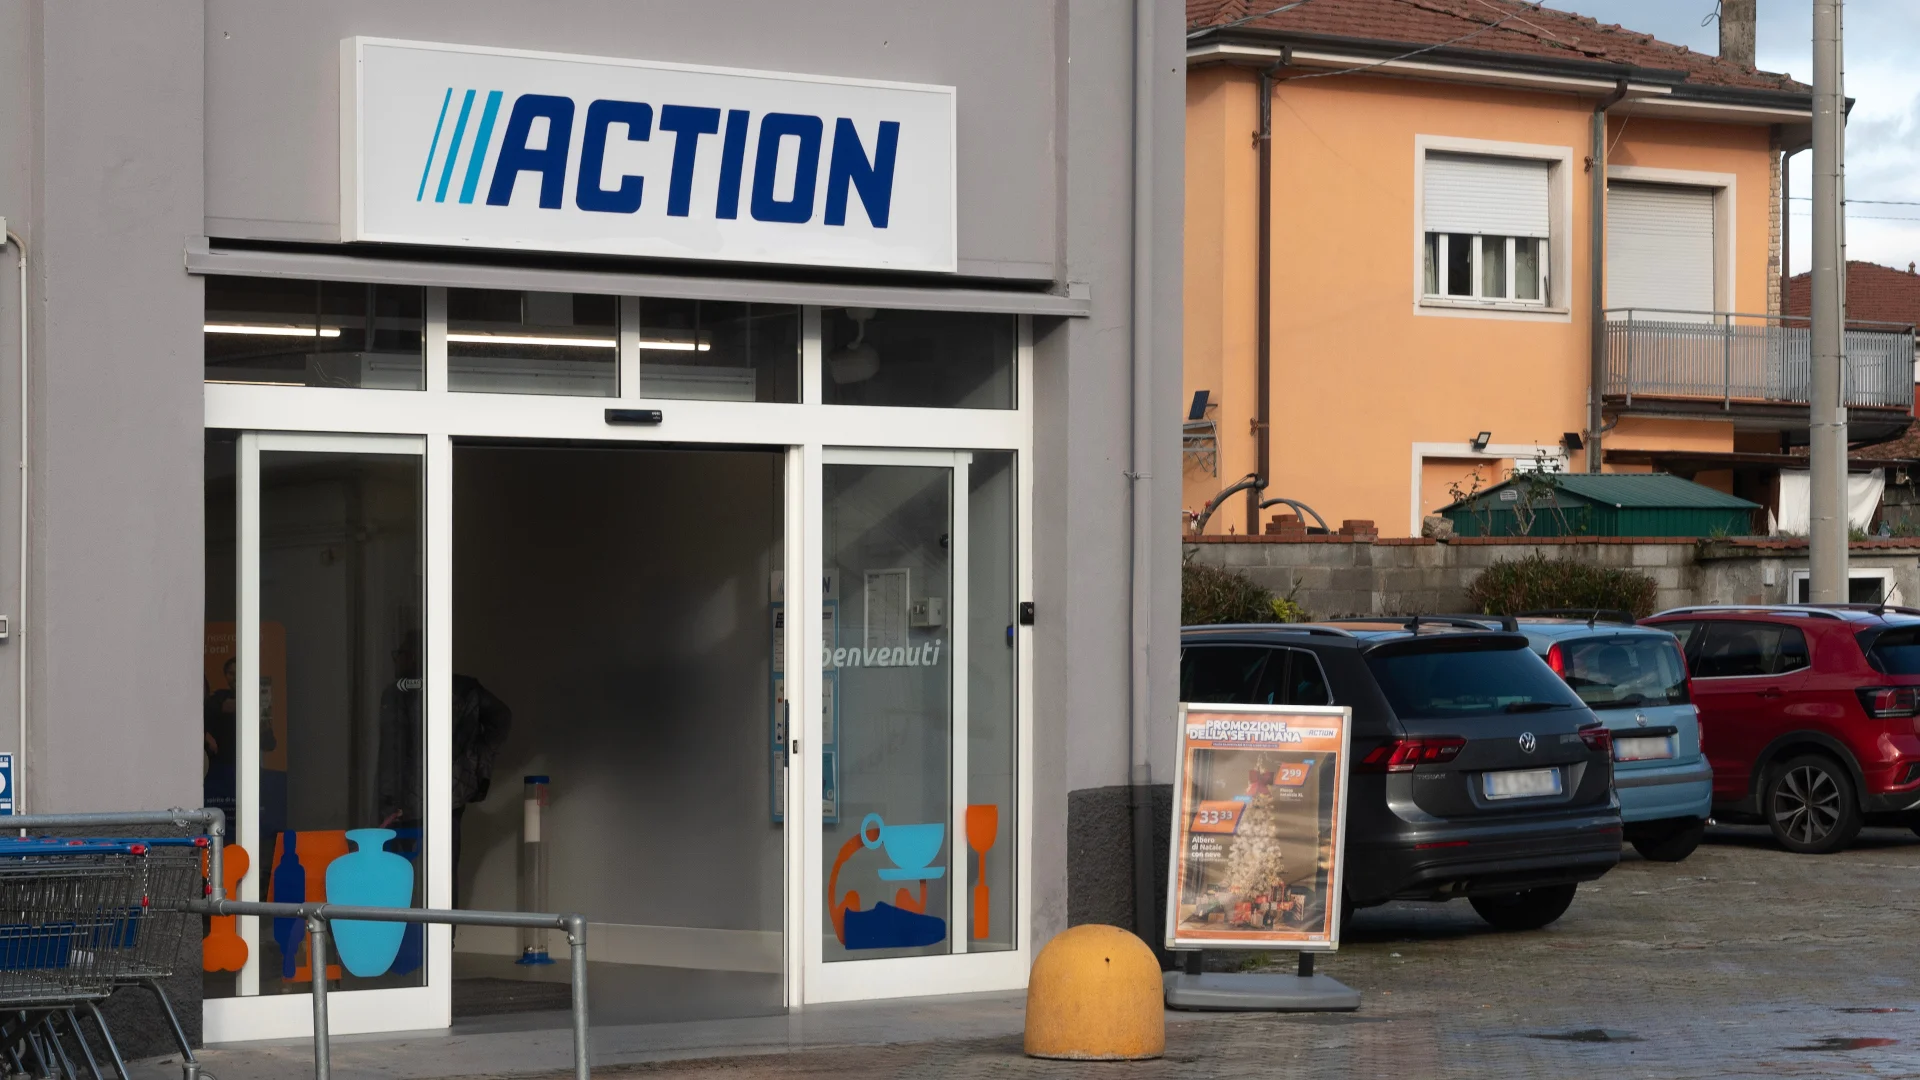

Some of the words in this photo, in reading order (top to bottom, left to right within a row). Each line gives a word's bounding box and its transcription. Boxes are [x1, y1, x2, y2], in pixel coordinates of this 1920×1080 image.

[486, 93, 900, 229] ACTION
[1205, 720, 1287, 732] PROMOZIONE
[1189, 729, 1230, 740] DELLA
[1231, 730, 1302, 743] SETTIMANA
[1308, 729, 1334, 737] ACTION
